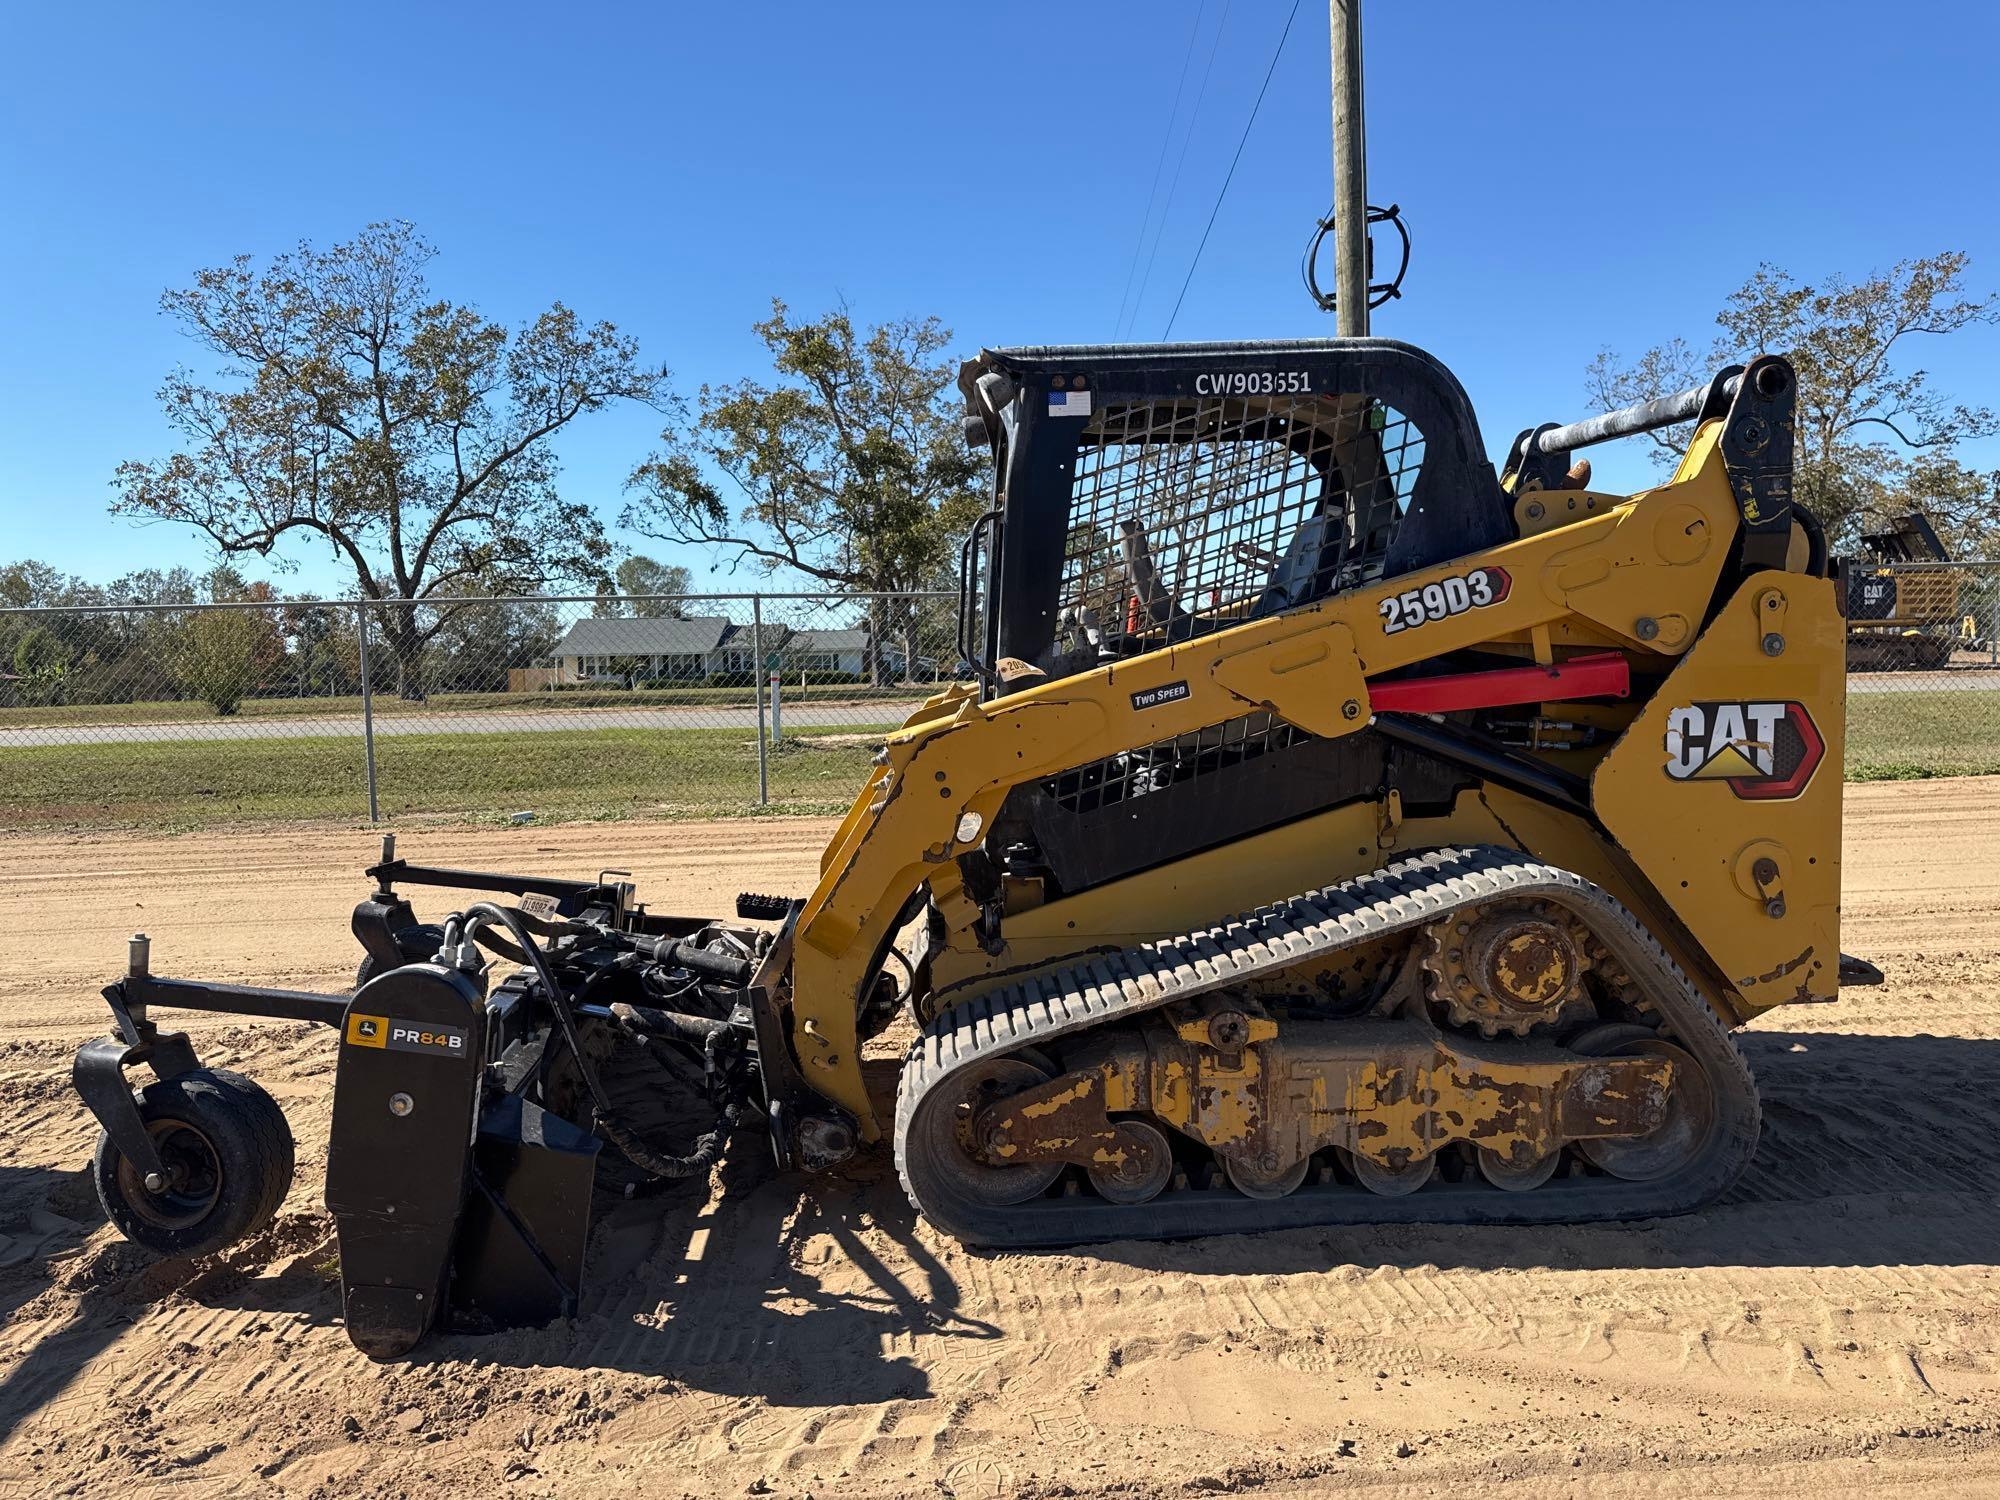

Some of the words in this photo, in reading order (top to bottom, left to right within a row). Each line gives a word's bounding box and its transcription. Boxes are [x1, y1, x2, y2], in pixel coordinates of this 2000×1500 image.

[1195, 371, 1312, 395] CW903651
[1380, 570, 1493, 634] 259D3
[1864, 585, 1884, 599] CAT
[1667, 704, 1786, 778] CAT
[393, 1028, 462, 1048] PR84B
